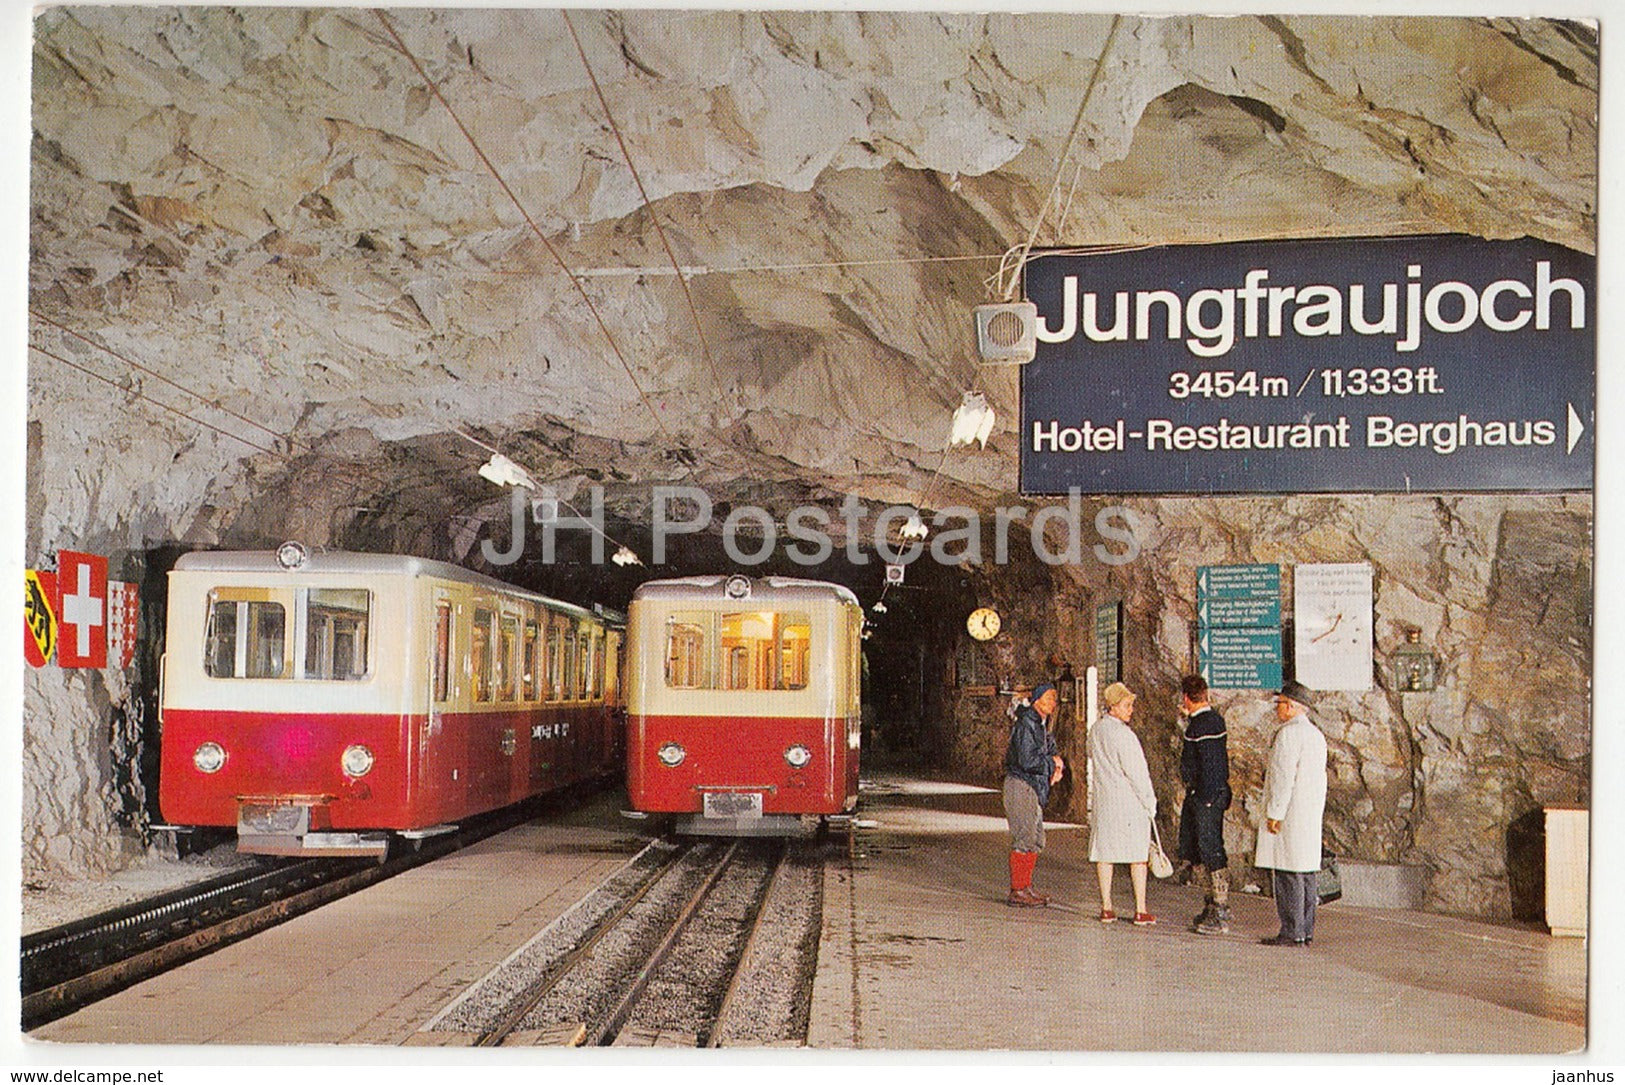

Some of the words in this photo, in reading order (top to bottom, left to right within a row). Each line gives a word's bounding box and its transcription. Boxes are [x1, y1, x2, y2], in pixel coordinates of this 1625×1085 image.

[1035, 261, 1586, 357] Jungfraujoch
[1033, 413, 1351, 452] Hotel-Restaurant
[1367, 414, 1556, 455] Berghaus
